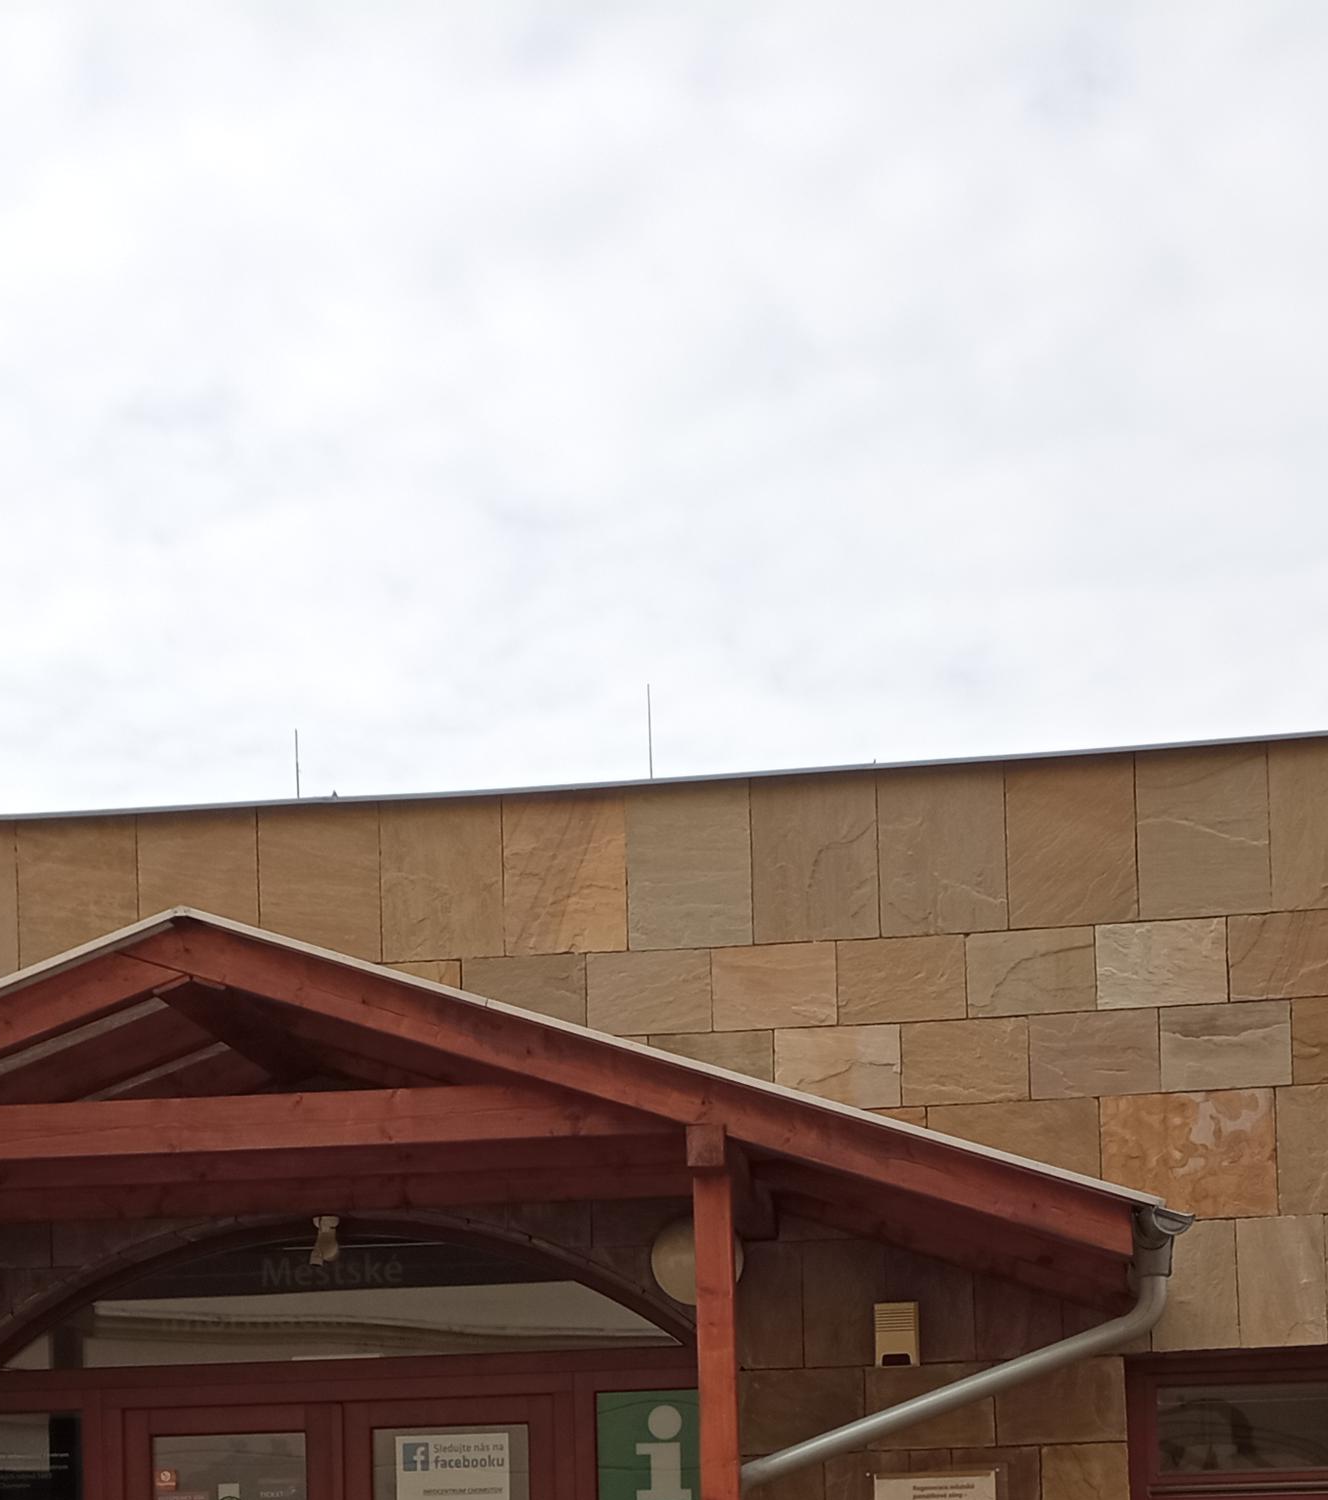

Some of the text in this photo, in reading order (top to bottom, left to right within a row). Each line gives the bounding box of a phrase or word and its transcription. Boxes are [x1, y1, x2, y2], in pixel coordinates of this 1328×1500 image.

[433, 1443, 504, 1455] Sledujte nás na
[432, 1455, 504, 1469] facebooku
